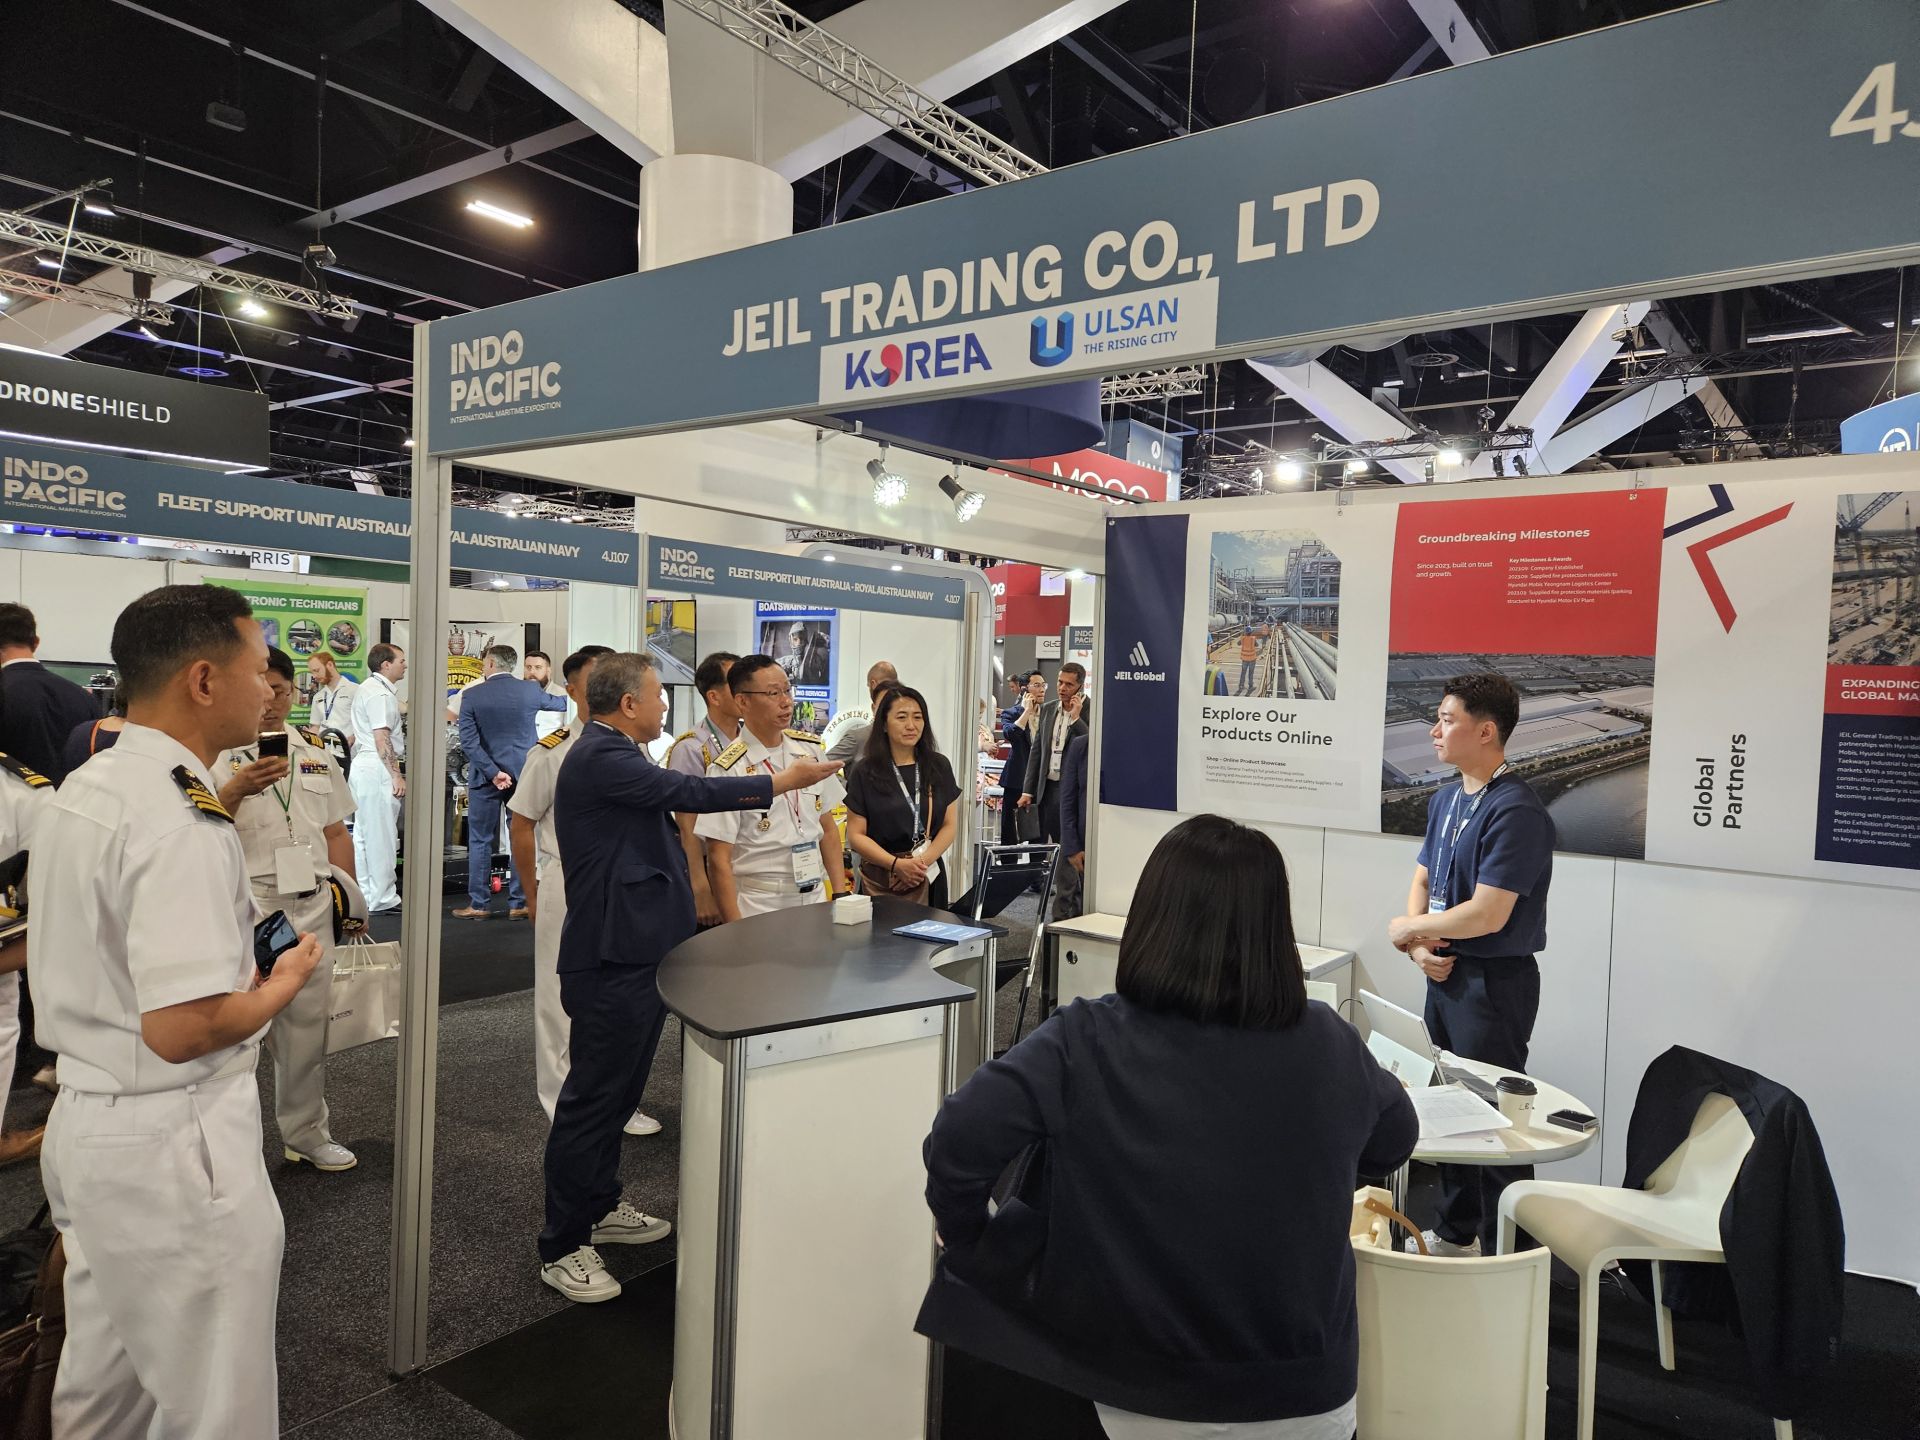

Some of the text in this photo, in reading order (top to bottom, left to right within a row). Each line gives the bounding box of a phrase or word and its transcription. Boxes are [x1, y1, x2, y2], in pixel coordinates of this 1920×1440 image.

[722, 297, 812, 357] JEIL
[820, 244, 1063, 338] TRADING
[1237, 178, 1381, 264] LTD
[1085, 297, 1179, 336] ULSAN
[450, 329, 524, 376] INDO
[1084, 330, 1178, 354] THE RISING CITY
[450, 361, 562, 412] PACIFIC
[0, 380, 171, 424] DRONESHIELD
[450, 400, 561, 425] INTERNATIONAL MARITIME EXPOSITION
[4, 456, 89, 485] INDO
[4, 478, 127, 511] PACIFIC
[158, 492, 212, 513] FLEET
[214, 499, 295, 523] SUPPORT
[296, 510, 335, 529] UNIT
[470, 533, 547, 554] AUSTRALIAN
[548, 543, 580, 558] NAVY
[1418, 527, 1591, 544] Groundbreaking Milestones
[660, 547, 698, 565] INDO
[1416, 562, 1434, 570] Since
[660, 561, 715, 581] PACIFIC
[728, 566, 754, 579] FLEET
[754, 570, 792, 584] SUPPORT
[792, 575, 811, 586] UNIT
[811, 577, 851, 591] AUSTRALIA
[855, 582, 877, 594] ROYAL
[877, 585, 917, 599] AUSTRALIAN
[917, 591, 934, 601] NAVY
[289, 598, 359, 611] TECHNICIANS
[1114, 671, 1166, 681] JEIL Global
[1841, 679, 1920, 689] EXPANDING
[1841, 690, 1920, 701] GLOBAL MA
[1202, 706, 1297, 724] Explore Our
[1202, 726, 1333, 746] Products Online
[1693, 757, 1715, 827] Global
[1722, 733, 1747, 829] Partners
